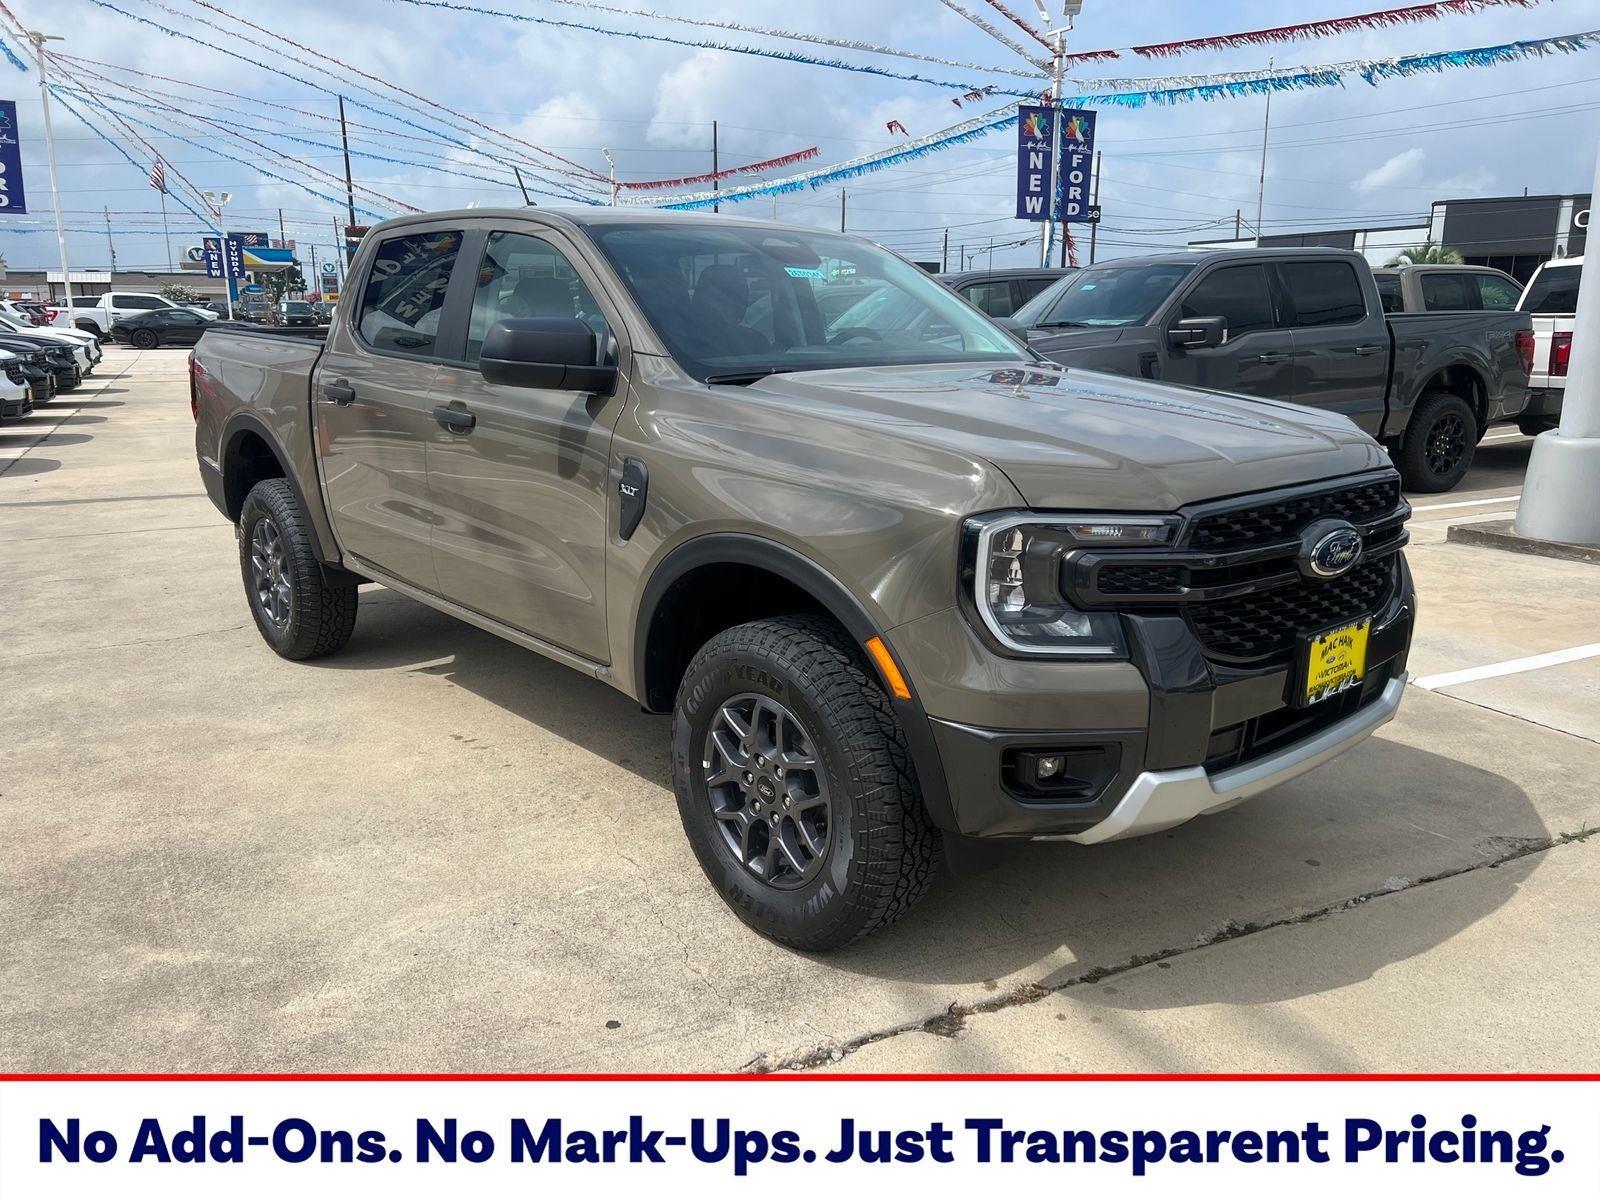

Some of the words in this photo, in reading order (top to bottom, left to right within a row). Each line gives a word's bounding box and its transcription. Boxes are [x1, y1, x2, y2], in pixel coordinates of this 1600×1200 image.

[1025, 152, 1043, 214] NEW
[1067, 154, 1083, 216] FORD
[210, 253, 221, 277] NEW
[229, 240, 240, 277] HYUNDAI
[620, 483, 639, 497] XLT
